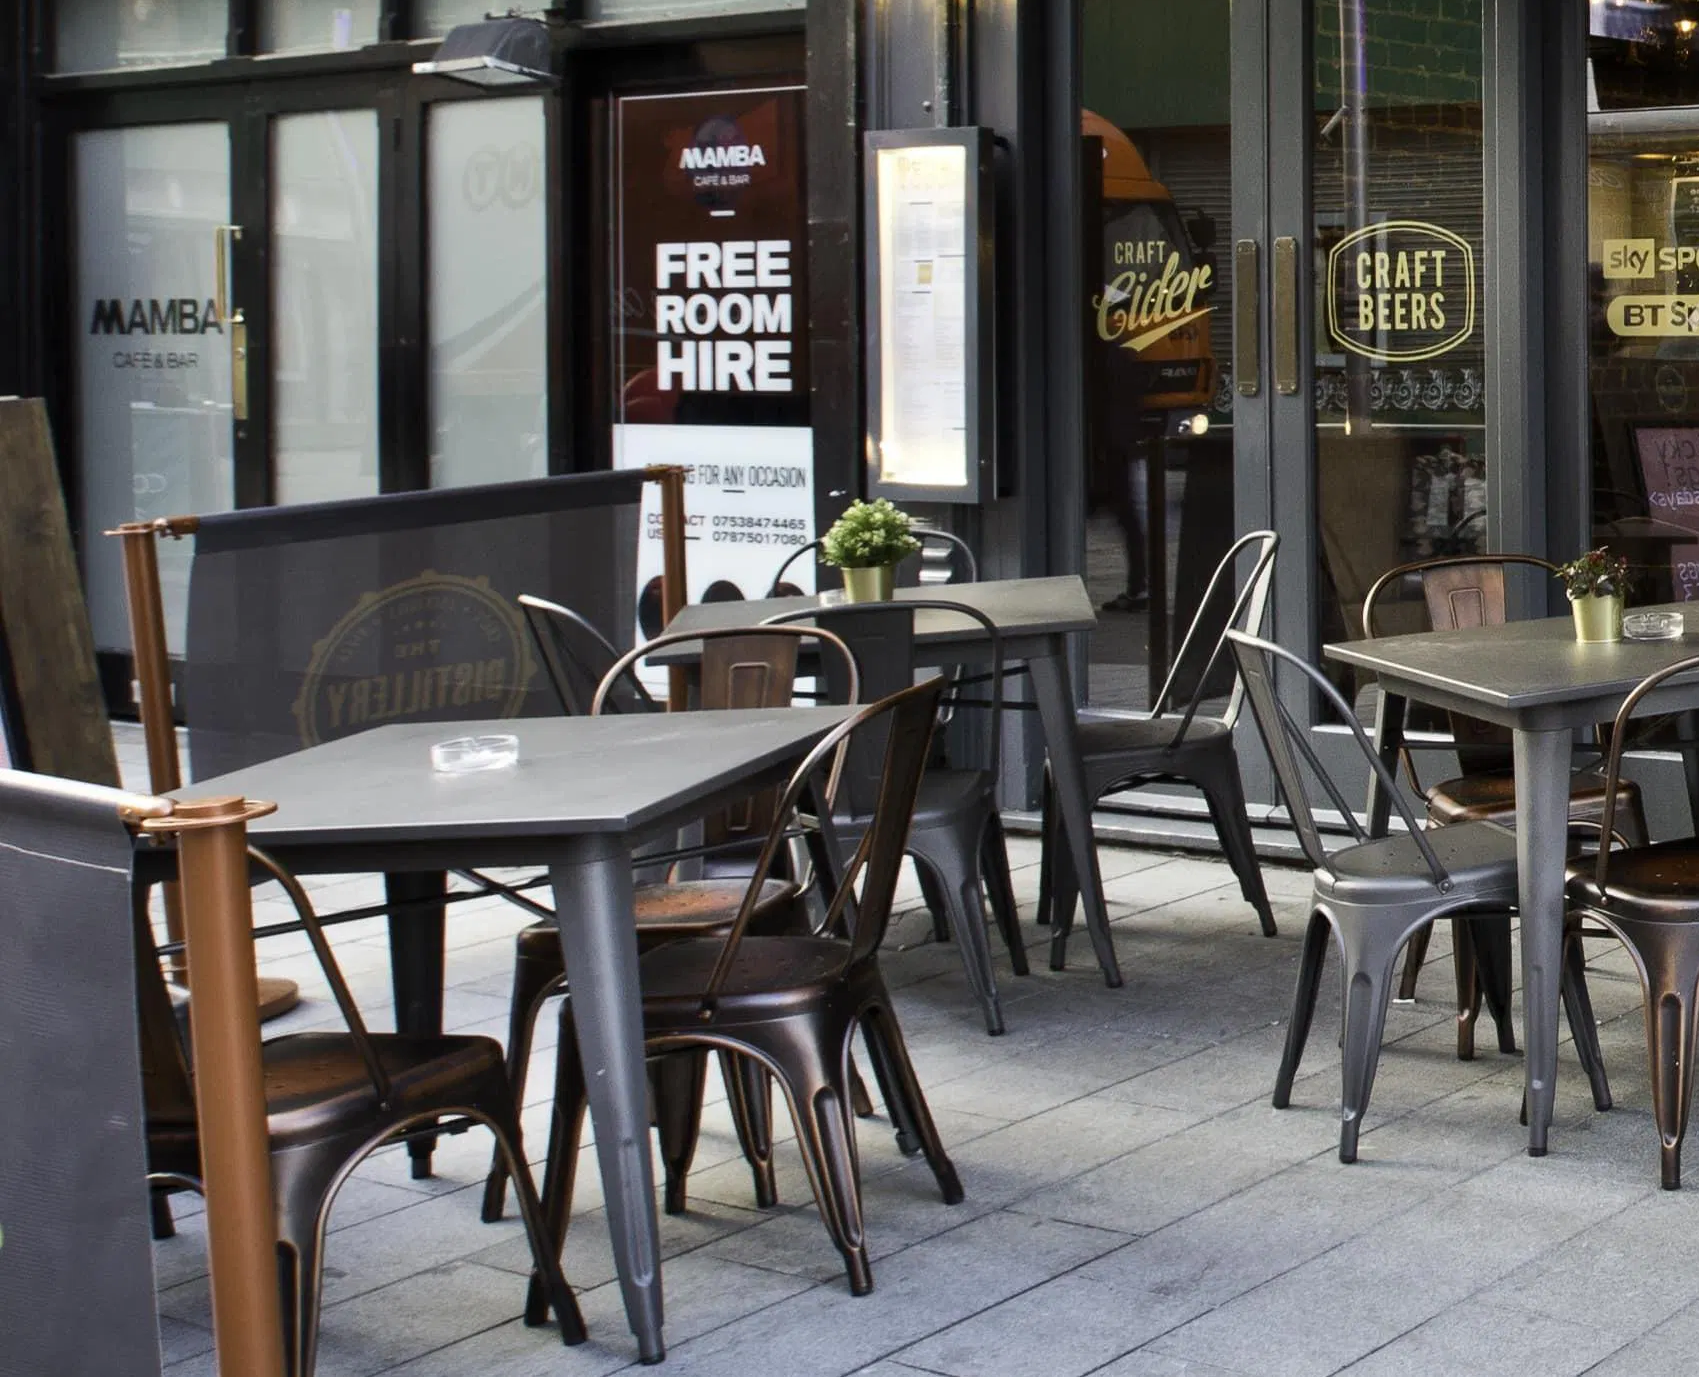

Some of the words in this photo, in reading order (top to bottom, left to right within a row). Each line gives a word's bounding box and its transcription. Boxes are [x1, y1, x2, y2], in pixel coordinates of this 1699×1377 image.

[679, 144, 767, 169] MAMBA
[656, 239, 792, 289] FREE
[1114, 241, 1167, 264] CRAFT
[1356, 250, 1446, 289] CRAFT
[1610, 245, 1649, 275] sky
[656, 293, 792, 334] ROOM
[1092, 252, 1213, 342] Cider
[1358, 291, 1446, 331] BEERS
[1623, 304, 1666, 327] BT
[90, 298, 224, 335] MAMBA
[657, 340, 793, 392] HIRE
[699, 464, 720, 485] FOR
[723, 465, 745, 486] ANY
[749, 466, 807, 488] OCCASION
[647, 513, 706, 527] COACT
